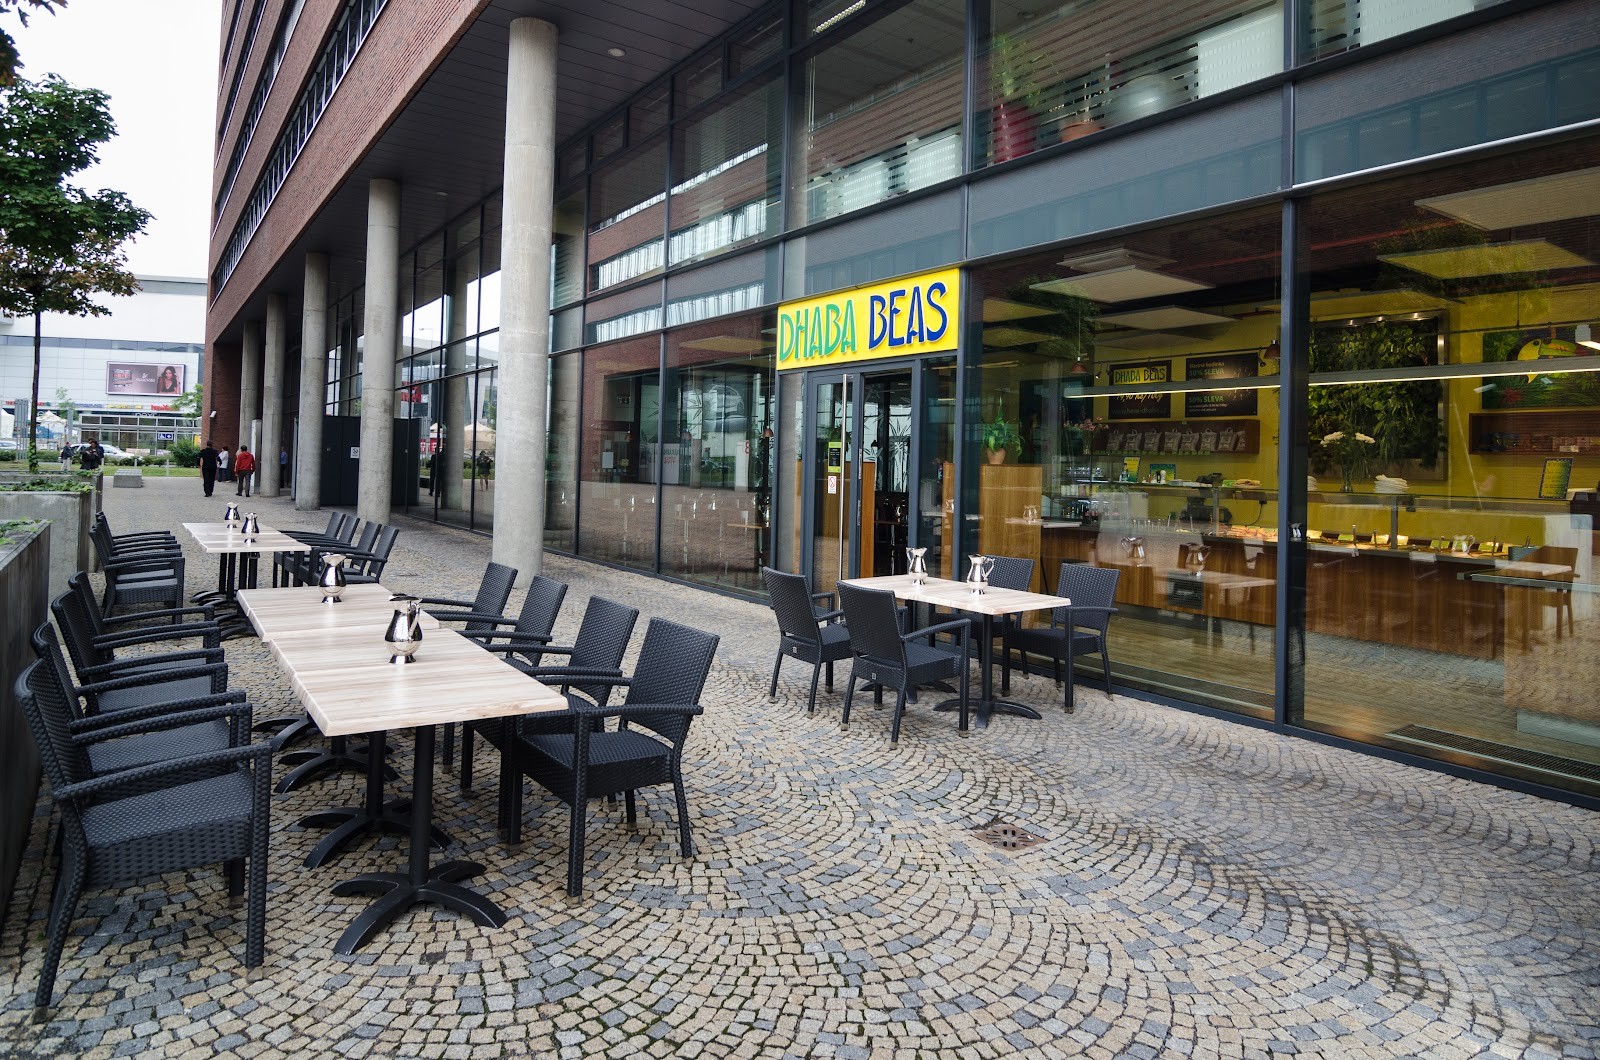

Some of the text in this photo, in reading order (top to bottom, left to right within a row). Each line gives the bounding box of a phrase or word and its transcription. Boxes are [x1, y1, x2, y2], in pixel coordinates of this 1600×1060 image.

[779, 281, 948, 361] DHABA BEAS
[1115, 368, 1165, 383] DHABA BEAS
[1204, 368, 1225, 376] SLEVA
[1203, 395, 1224, 403] SLEVA
